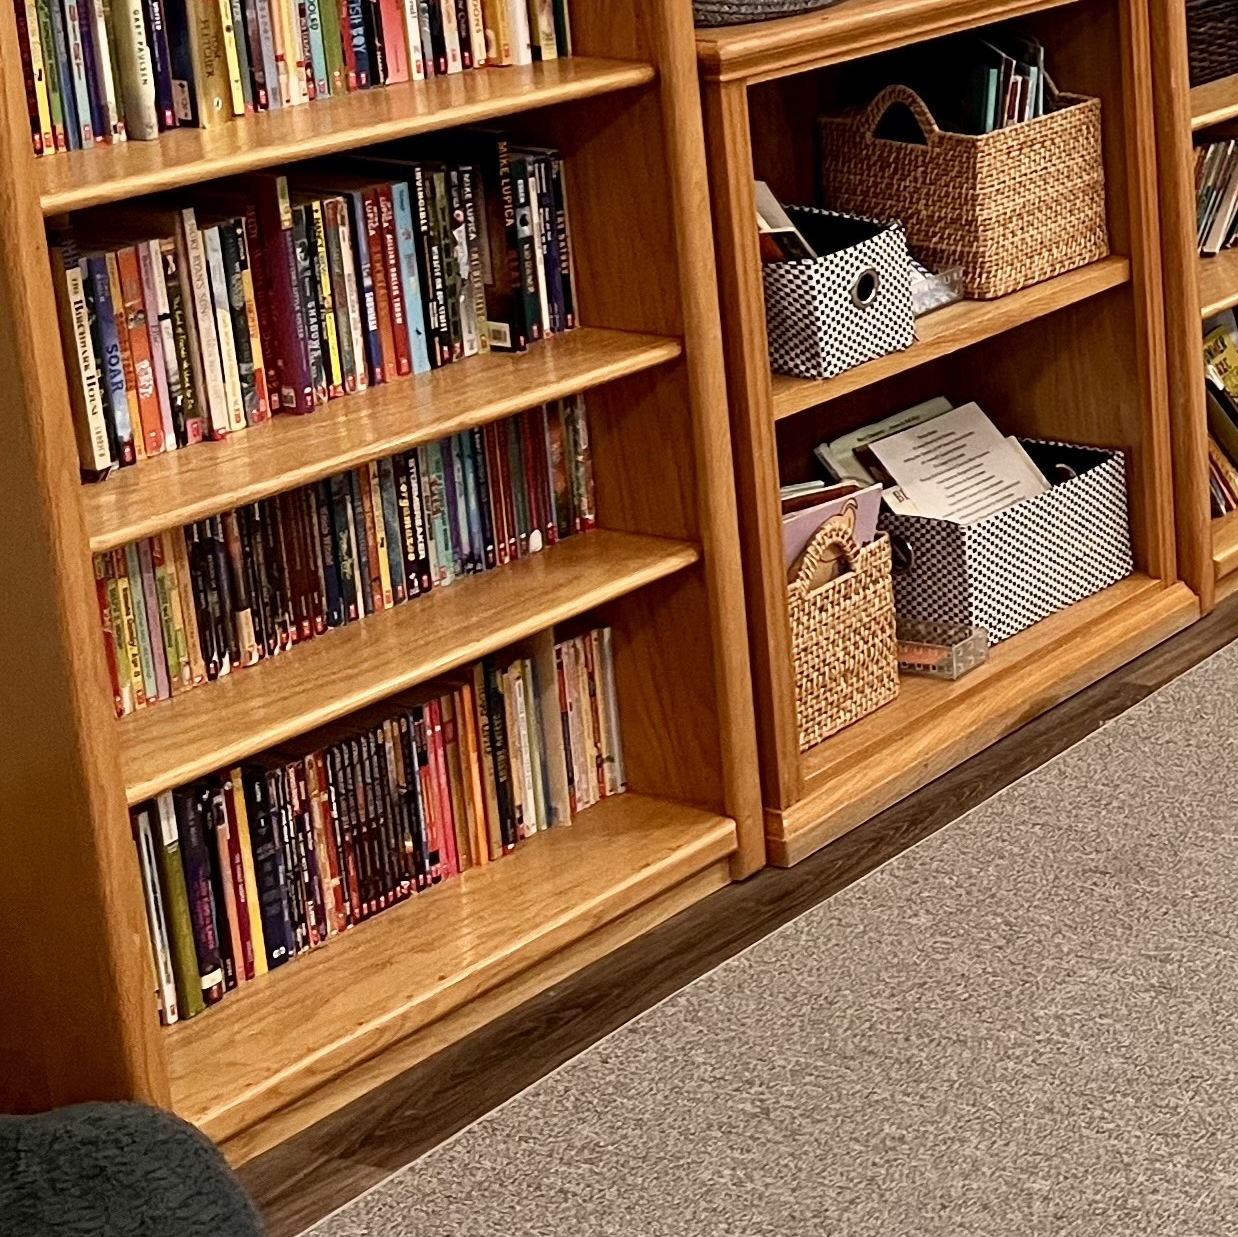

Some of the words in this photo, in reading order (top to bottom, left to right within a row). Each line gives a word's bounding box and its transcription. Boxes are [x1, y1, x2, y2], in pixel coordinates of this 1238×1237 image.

[132, 8, 142, 37] GARY
[151, 1, 163, 31] UNITED
[199, 18, 216, 80] FLETCHER
[353, 27, 367, 55] BOY
[136, 41, 149, 86] PAULSEN
[498, 140, 510, 176] MIKE
[414, 167, 428, 232] INVINCIBLE
[462, 173, 473, 200] MIKE
[501, 178, 516, 227] LUPICA
[365, 199, 377, 237] LUPICA
[464, 202, 478, 241] LUPICA
[306, 300, 321, 352] SHADOWS
[74, 298, 92, 372] BIRCHBARK
[85, 374, 98, 417] HOUSE
[178, 335, 189, 359] Friends
[105, 343, 125, 393] SOAR
[408, 458, 427, 560] STORMBREAKER
[131, 651, 140, 668] Age
